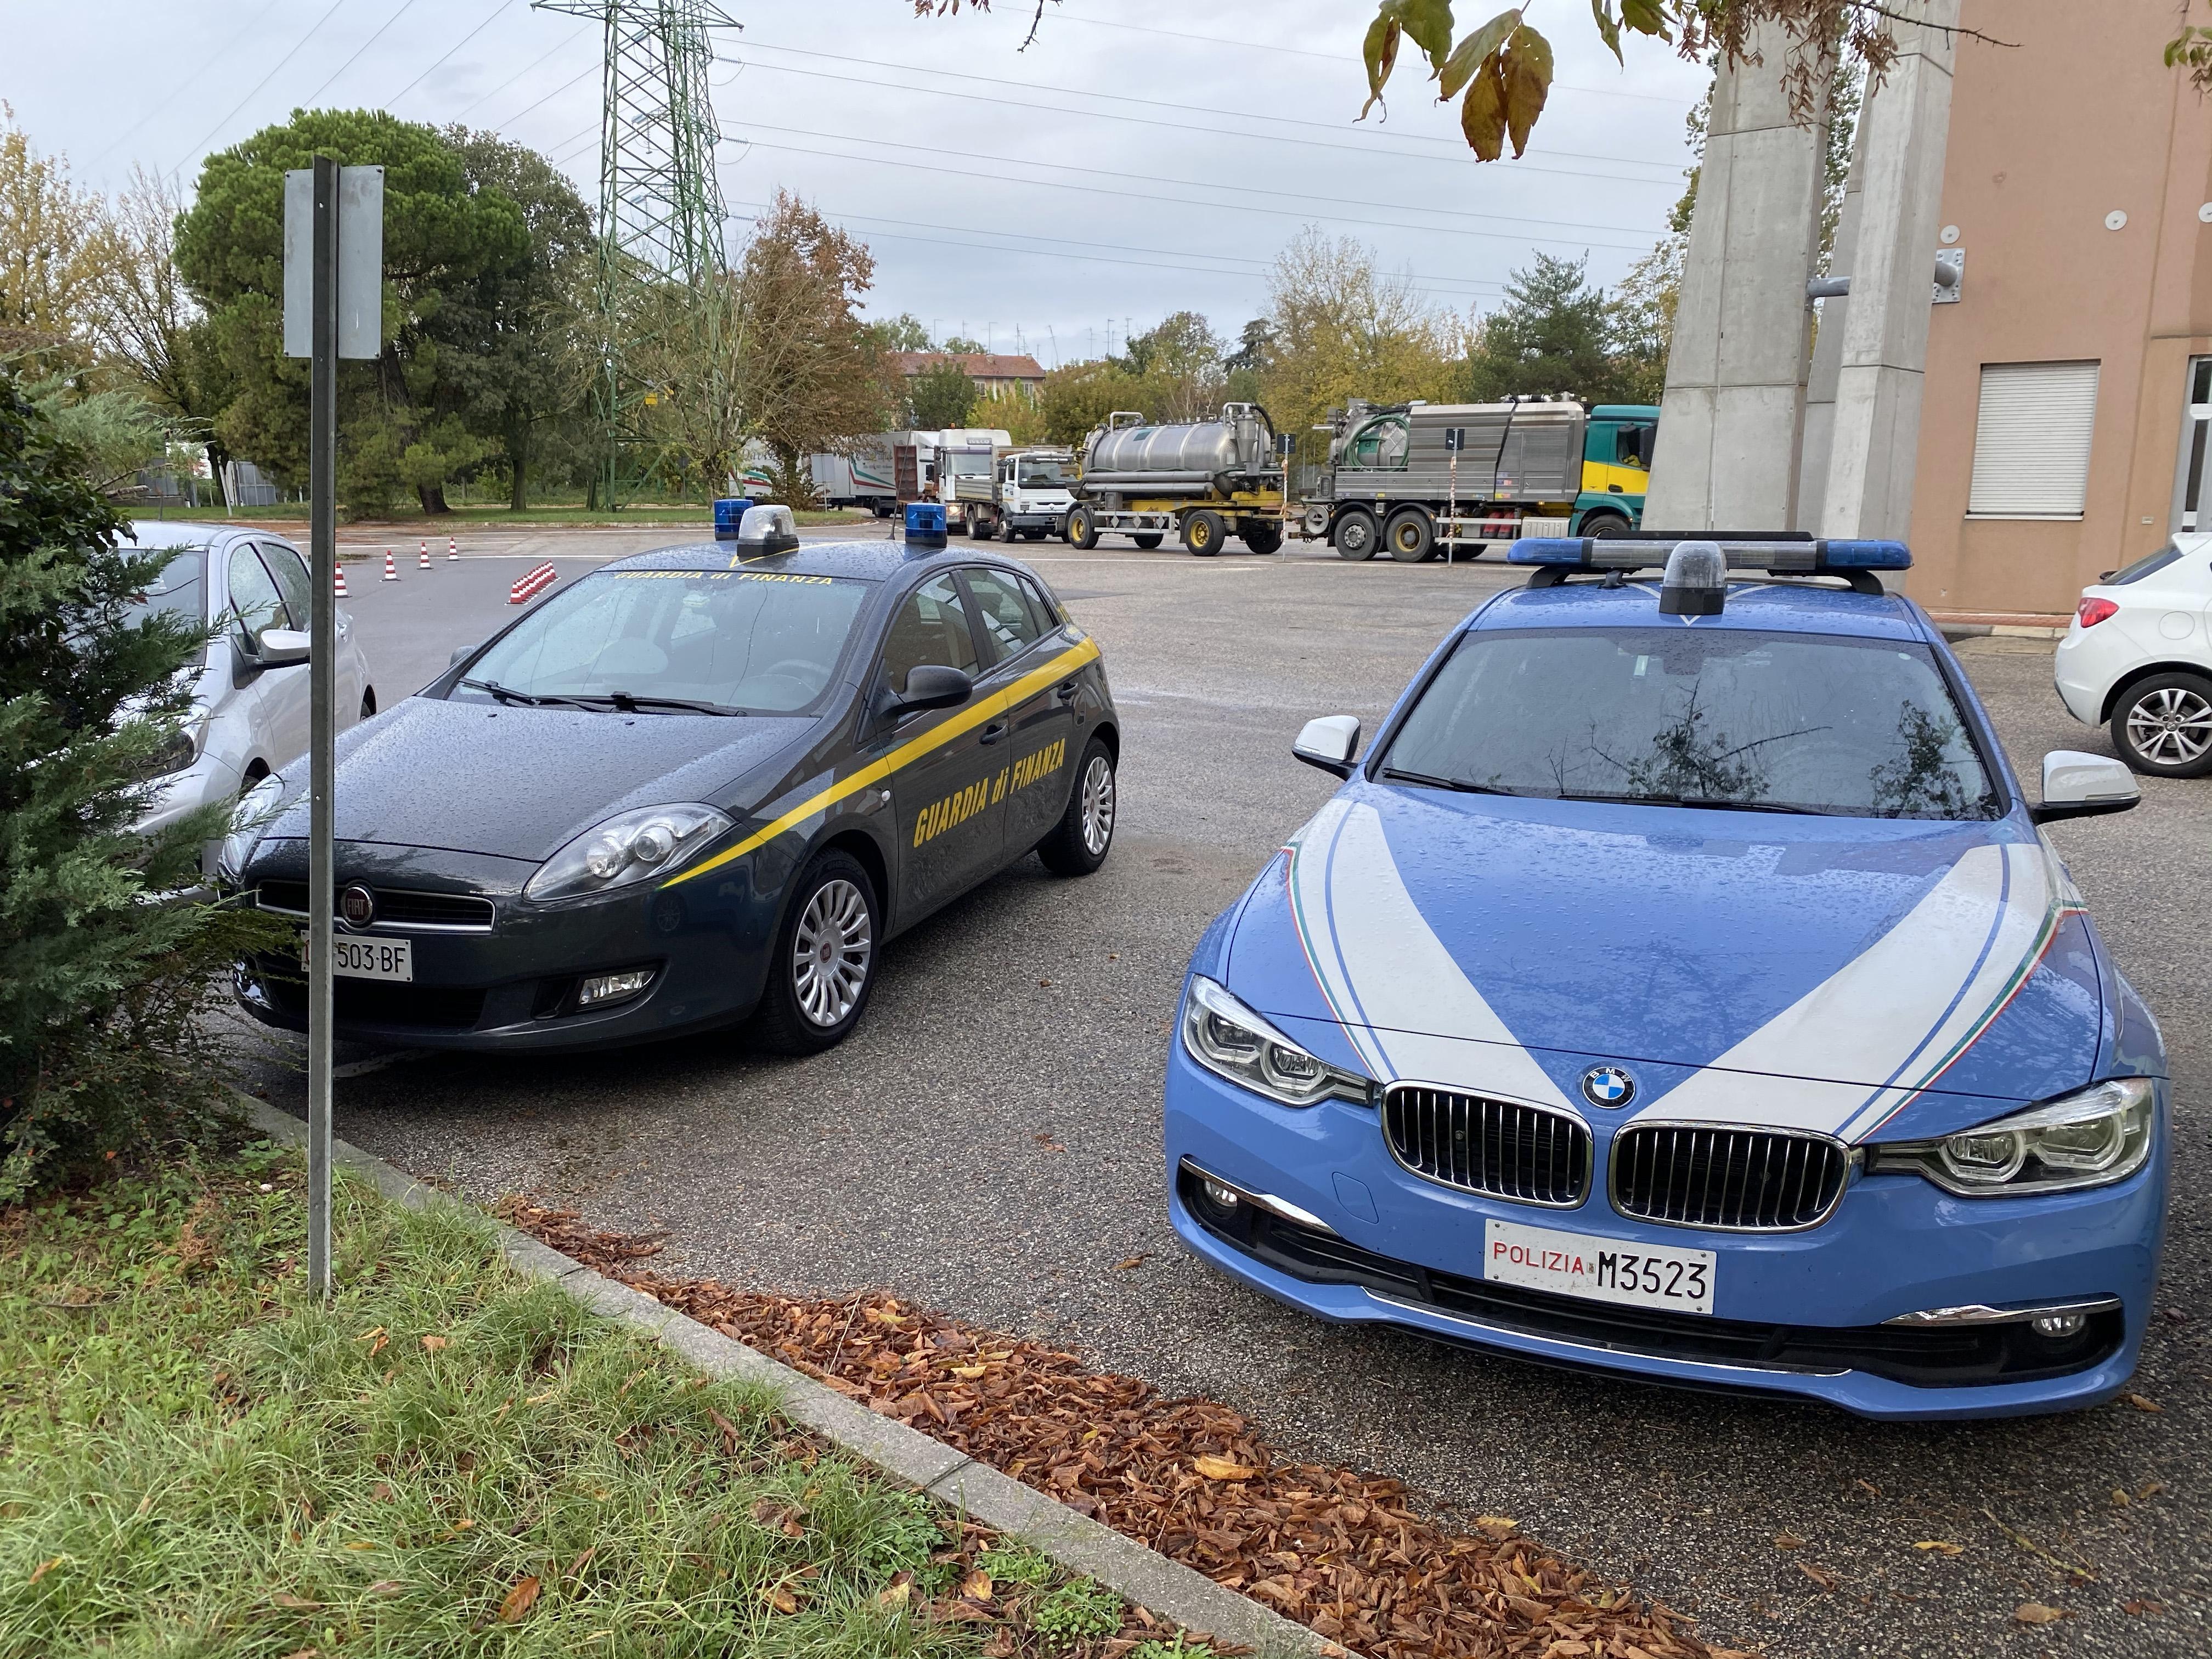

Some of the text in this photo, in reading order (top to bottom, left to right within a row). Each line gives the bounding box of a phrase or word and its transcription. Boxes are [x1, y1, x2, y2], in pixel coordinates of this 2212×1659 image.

[738, 573, 833, 585] FINANZA
[913, 738, 1065, 848] GUARDIA di FINANZA
[347, 898, 365, 915] FIAT
[1589, 1068, 1632, 1082] BMW
[1493, 1242, 1708, 1300] POLIZIA M3523
